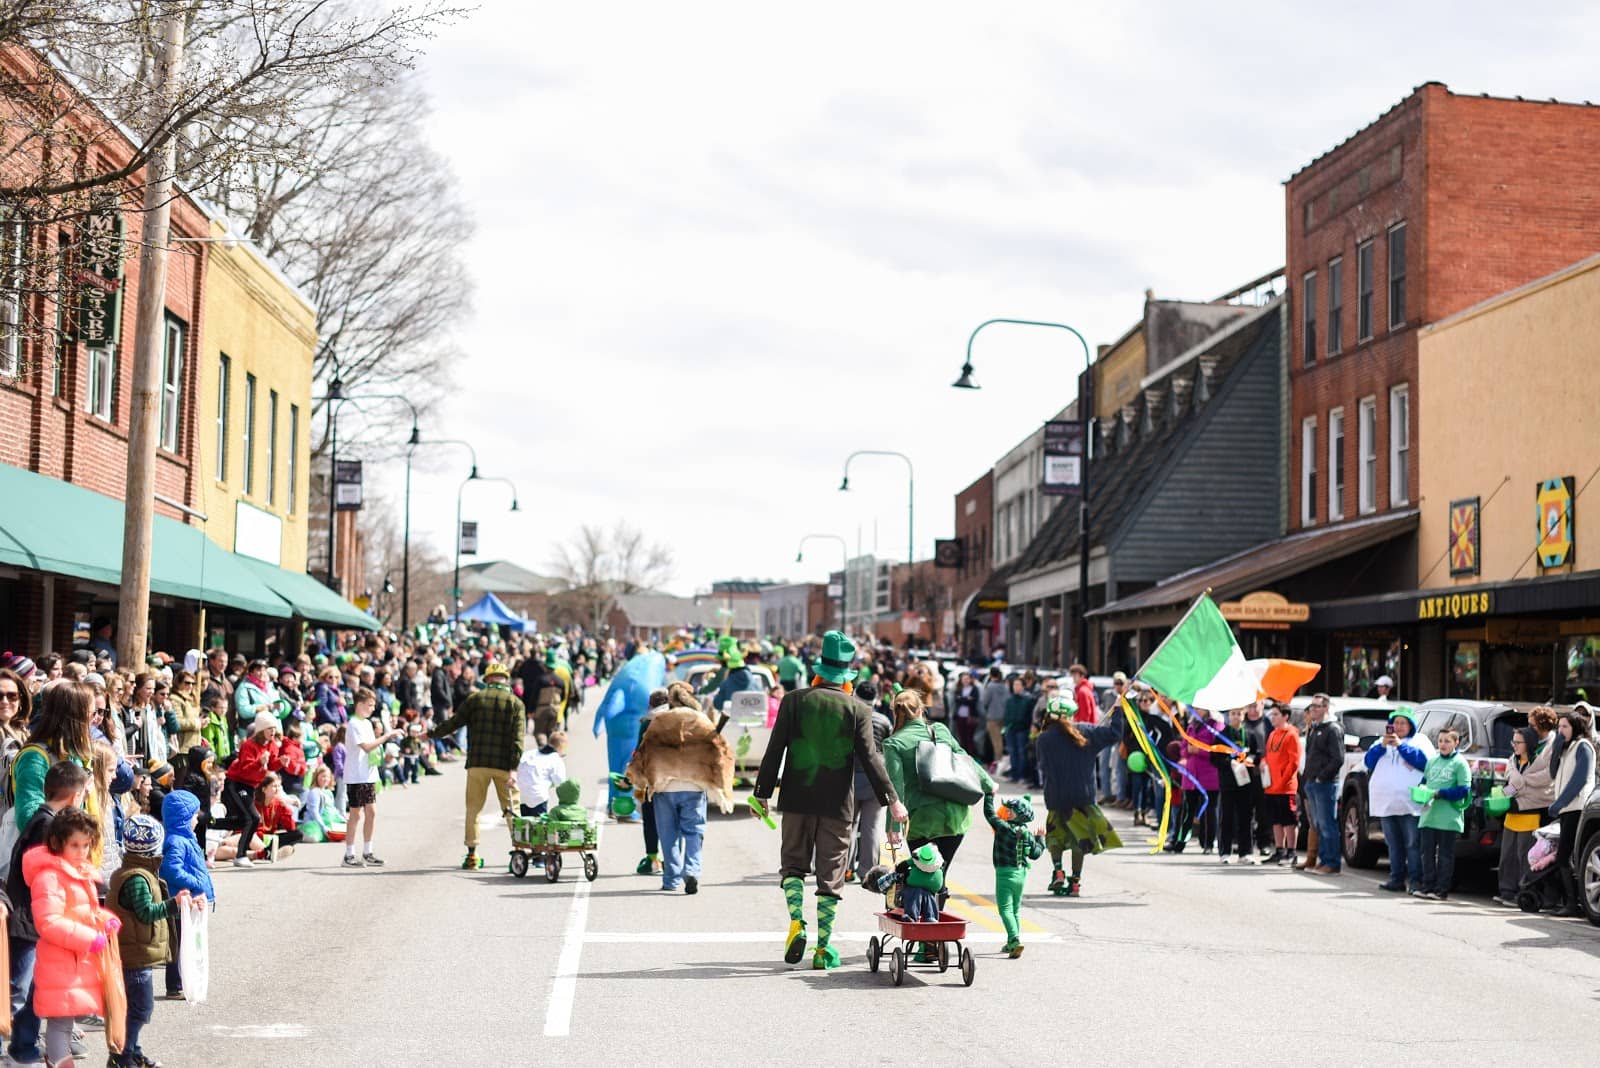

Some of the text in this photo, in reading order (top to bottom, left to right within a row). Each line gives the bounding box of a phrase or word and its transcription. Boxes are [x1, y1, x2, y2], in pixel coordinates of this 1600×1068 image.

[83, 269, 113, 291] GENERAL
[88, 287, 106, 340] STORE
[1419, 592, 1488, 619] ANTIQUES
